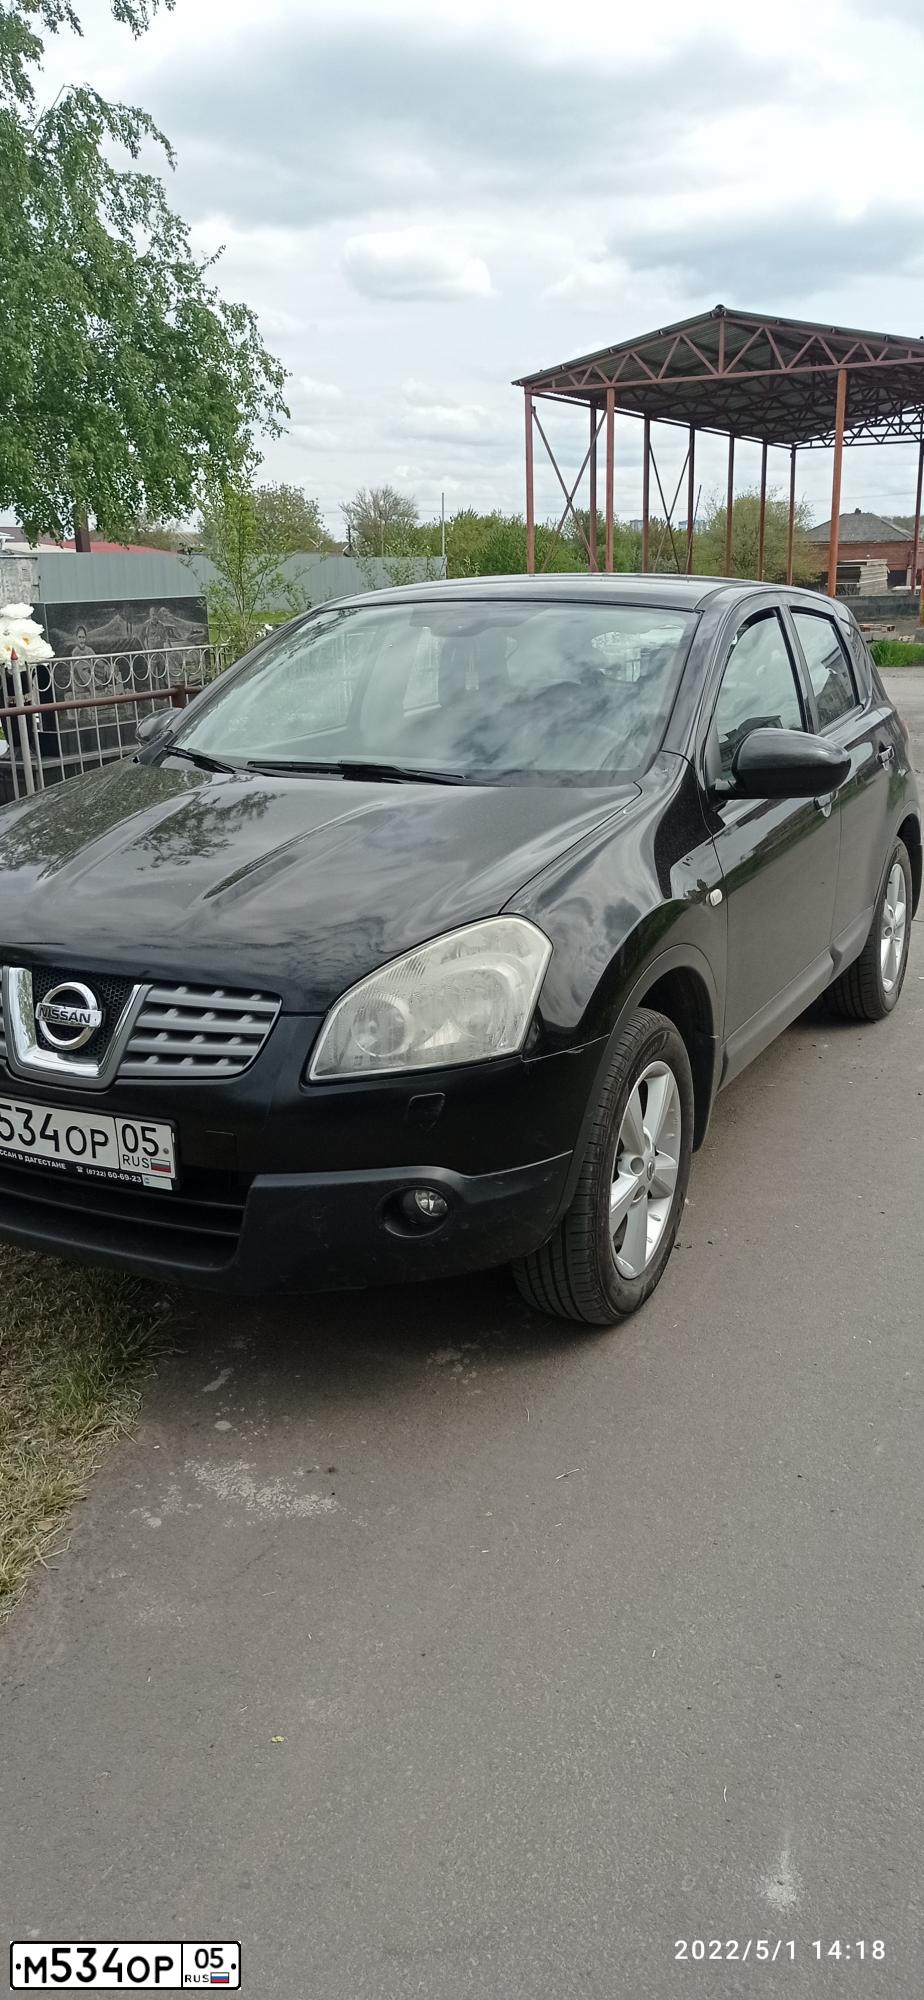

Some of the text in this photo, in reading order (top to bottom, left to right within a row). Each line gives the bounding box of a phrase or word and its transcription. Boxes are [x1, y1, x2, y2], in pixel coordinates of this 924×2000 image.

[39, 1006, 91, 1024] NISSAN
[121, 1123, 159, 1157] 05
[122, 1154, 149, 1168] RUS
